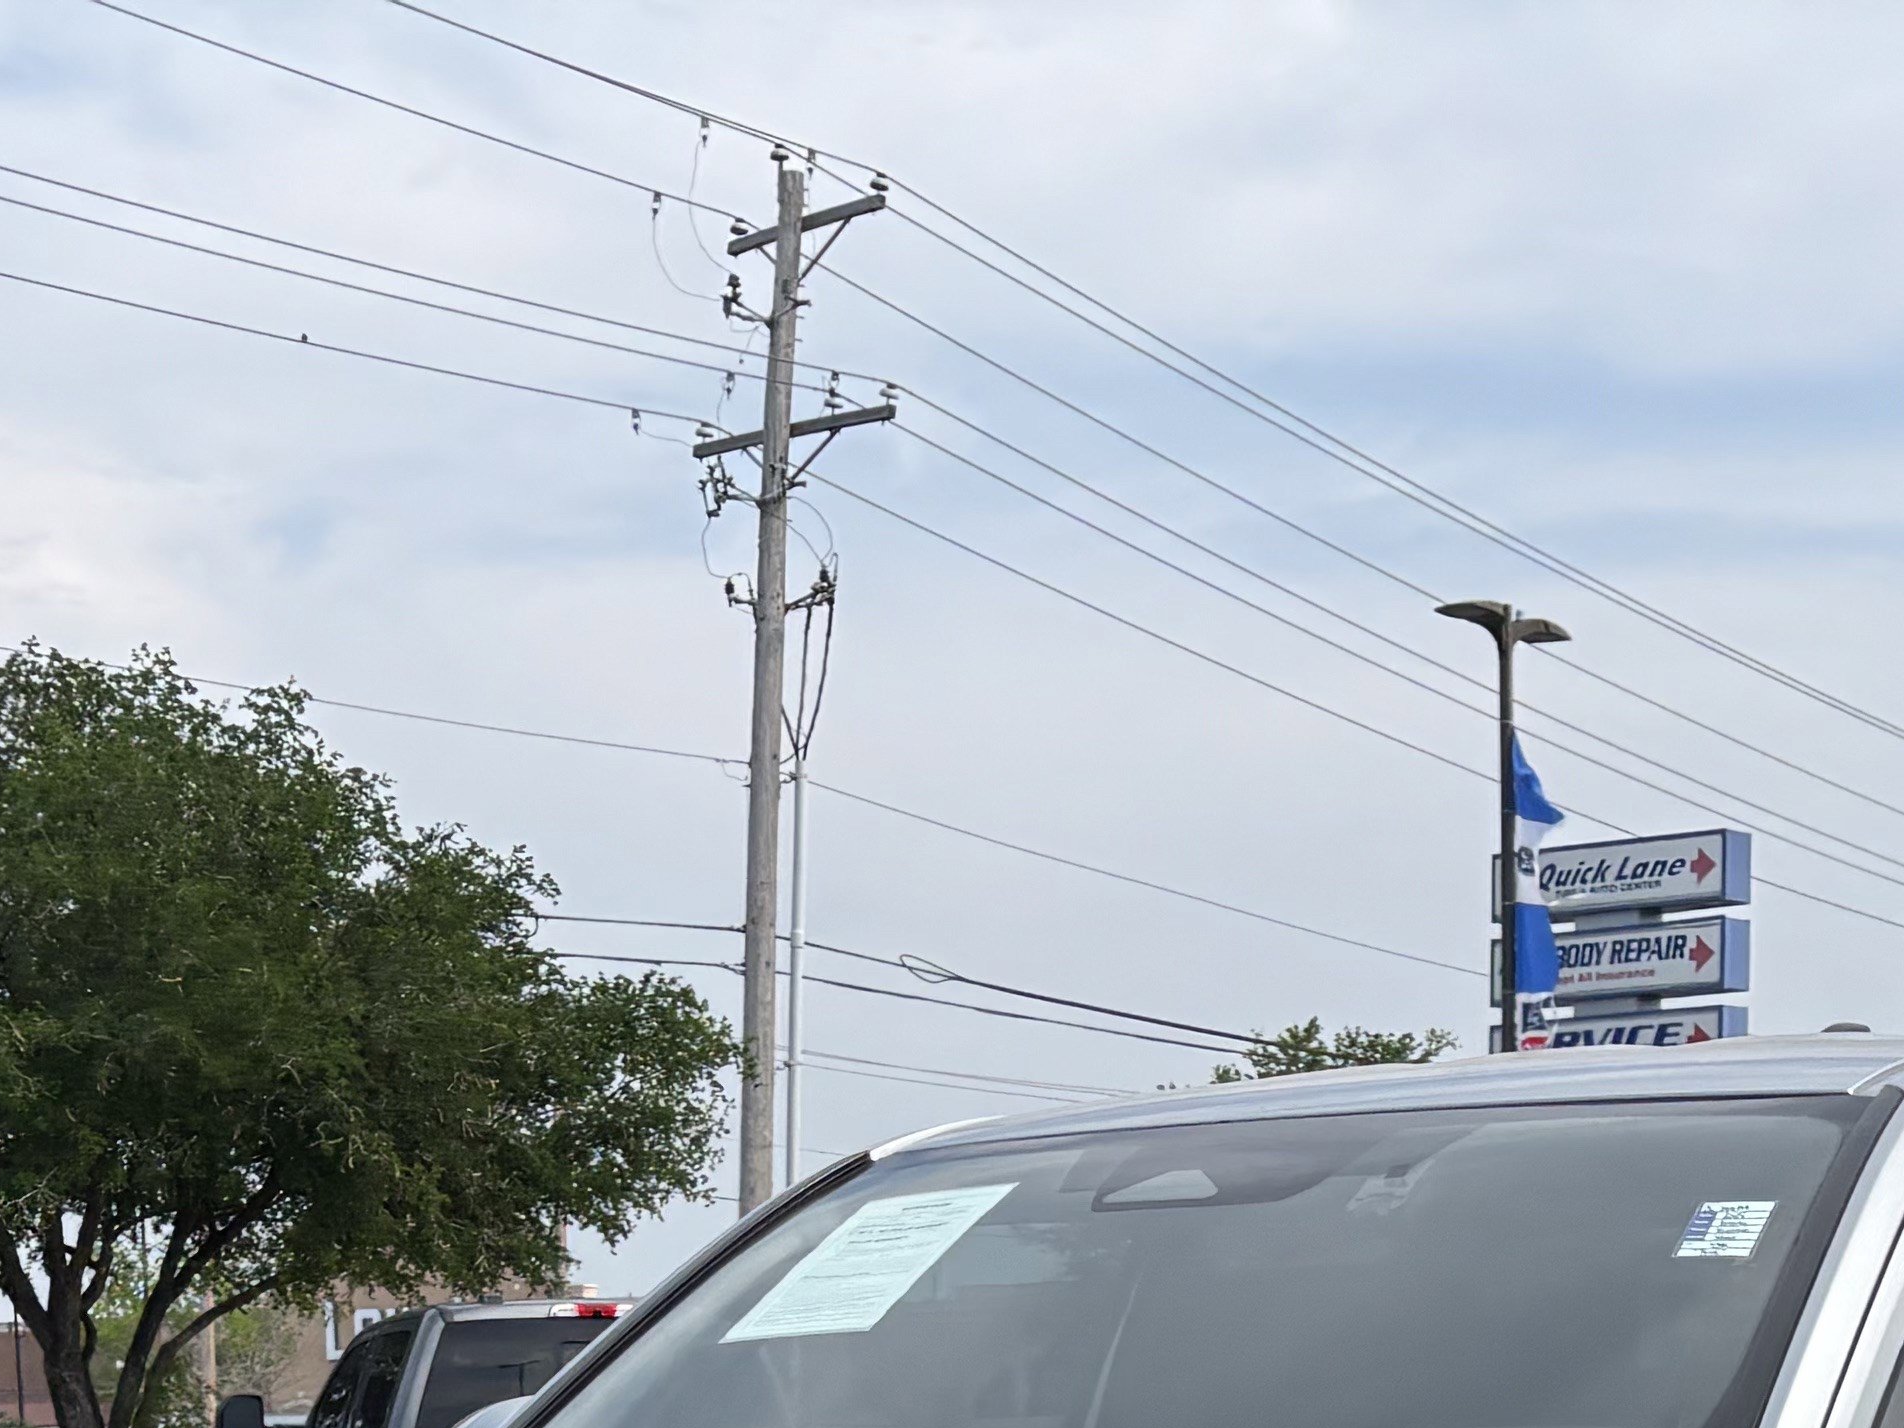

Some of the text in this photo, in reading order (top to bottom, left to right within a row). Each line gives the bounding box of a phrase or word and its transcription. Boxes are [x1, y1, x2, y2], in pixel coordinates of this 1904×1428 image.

[1539, 858, 1611, 893] Quick
[1613, 855, 1687, 880] Lane
[1558, 934, 1688, 968] BODY REPAIR
[1552, 1022, 1684, 1049] RVICE
